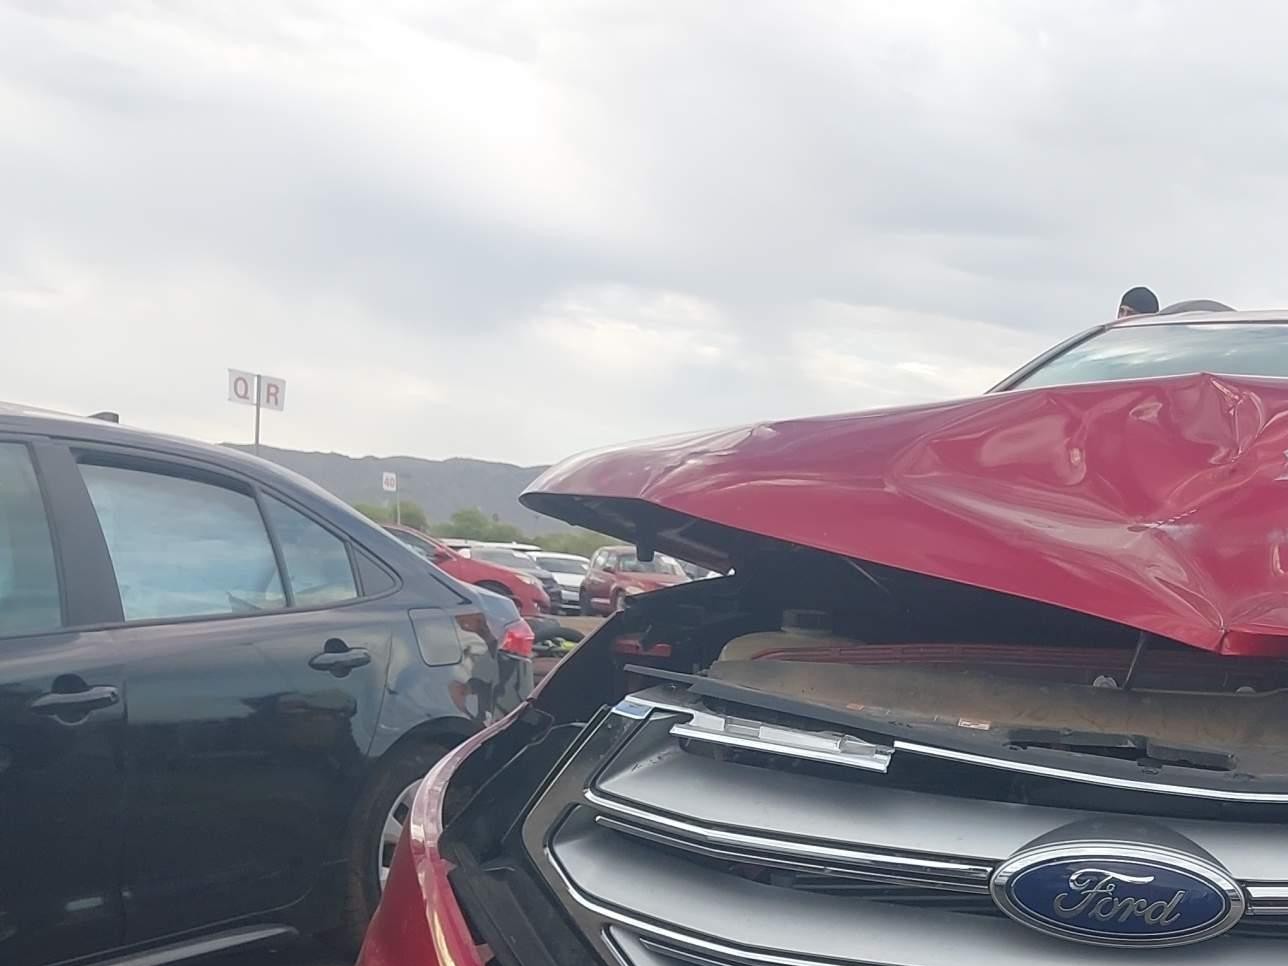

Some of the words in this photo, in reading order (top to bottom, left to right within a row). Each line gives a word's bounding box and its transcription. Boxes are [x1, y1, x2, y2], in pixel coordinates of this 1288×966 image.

[233, 376, 249, 400] Q
[266, 383, 280, 406] R
[1053, 868, 1186, 926] Ford
